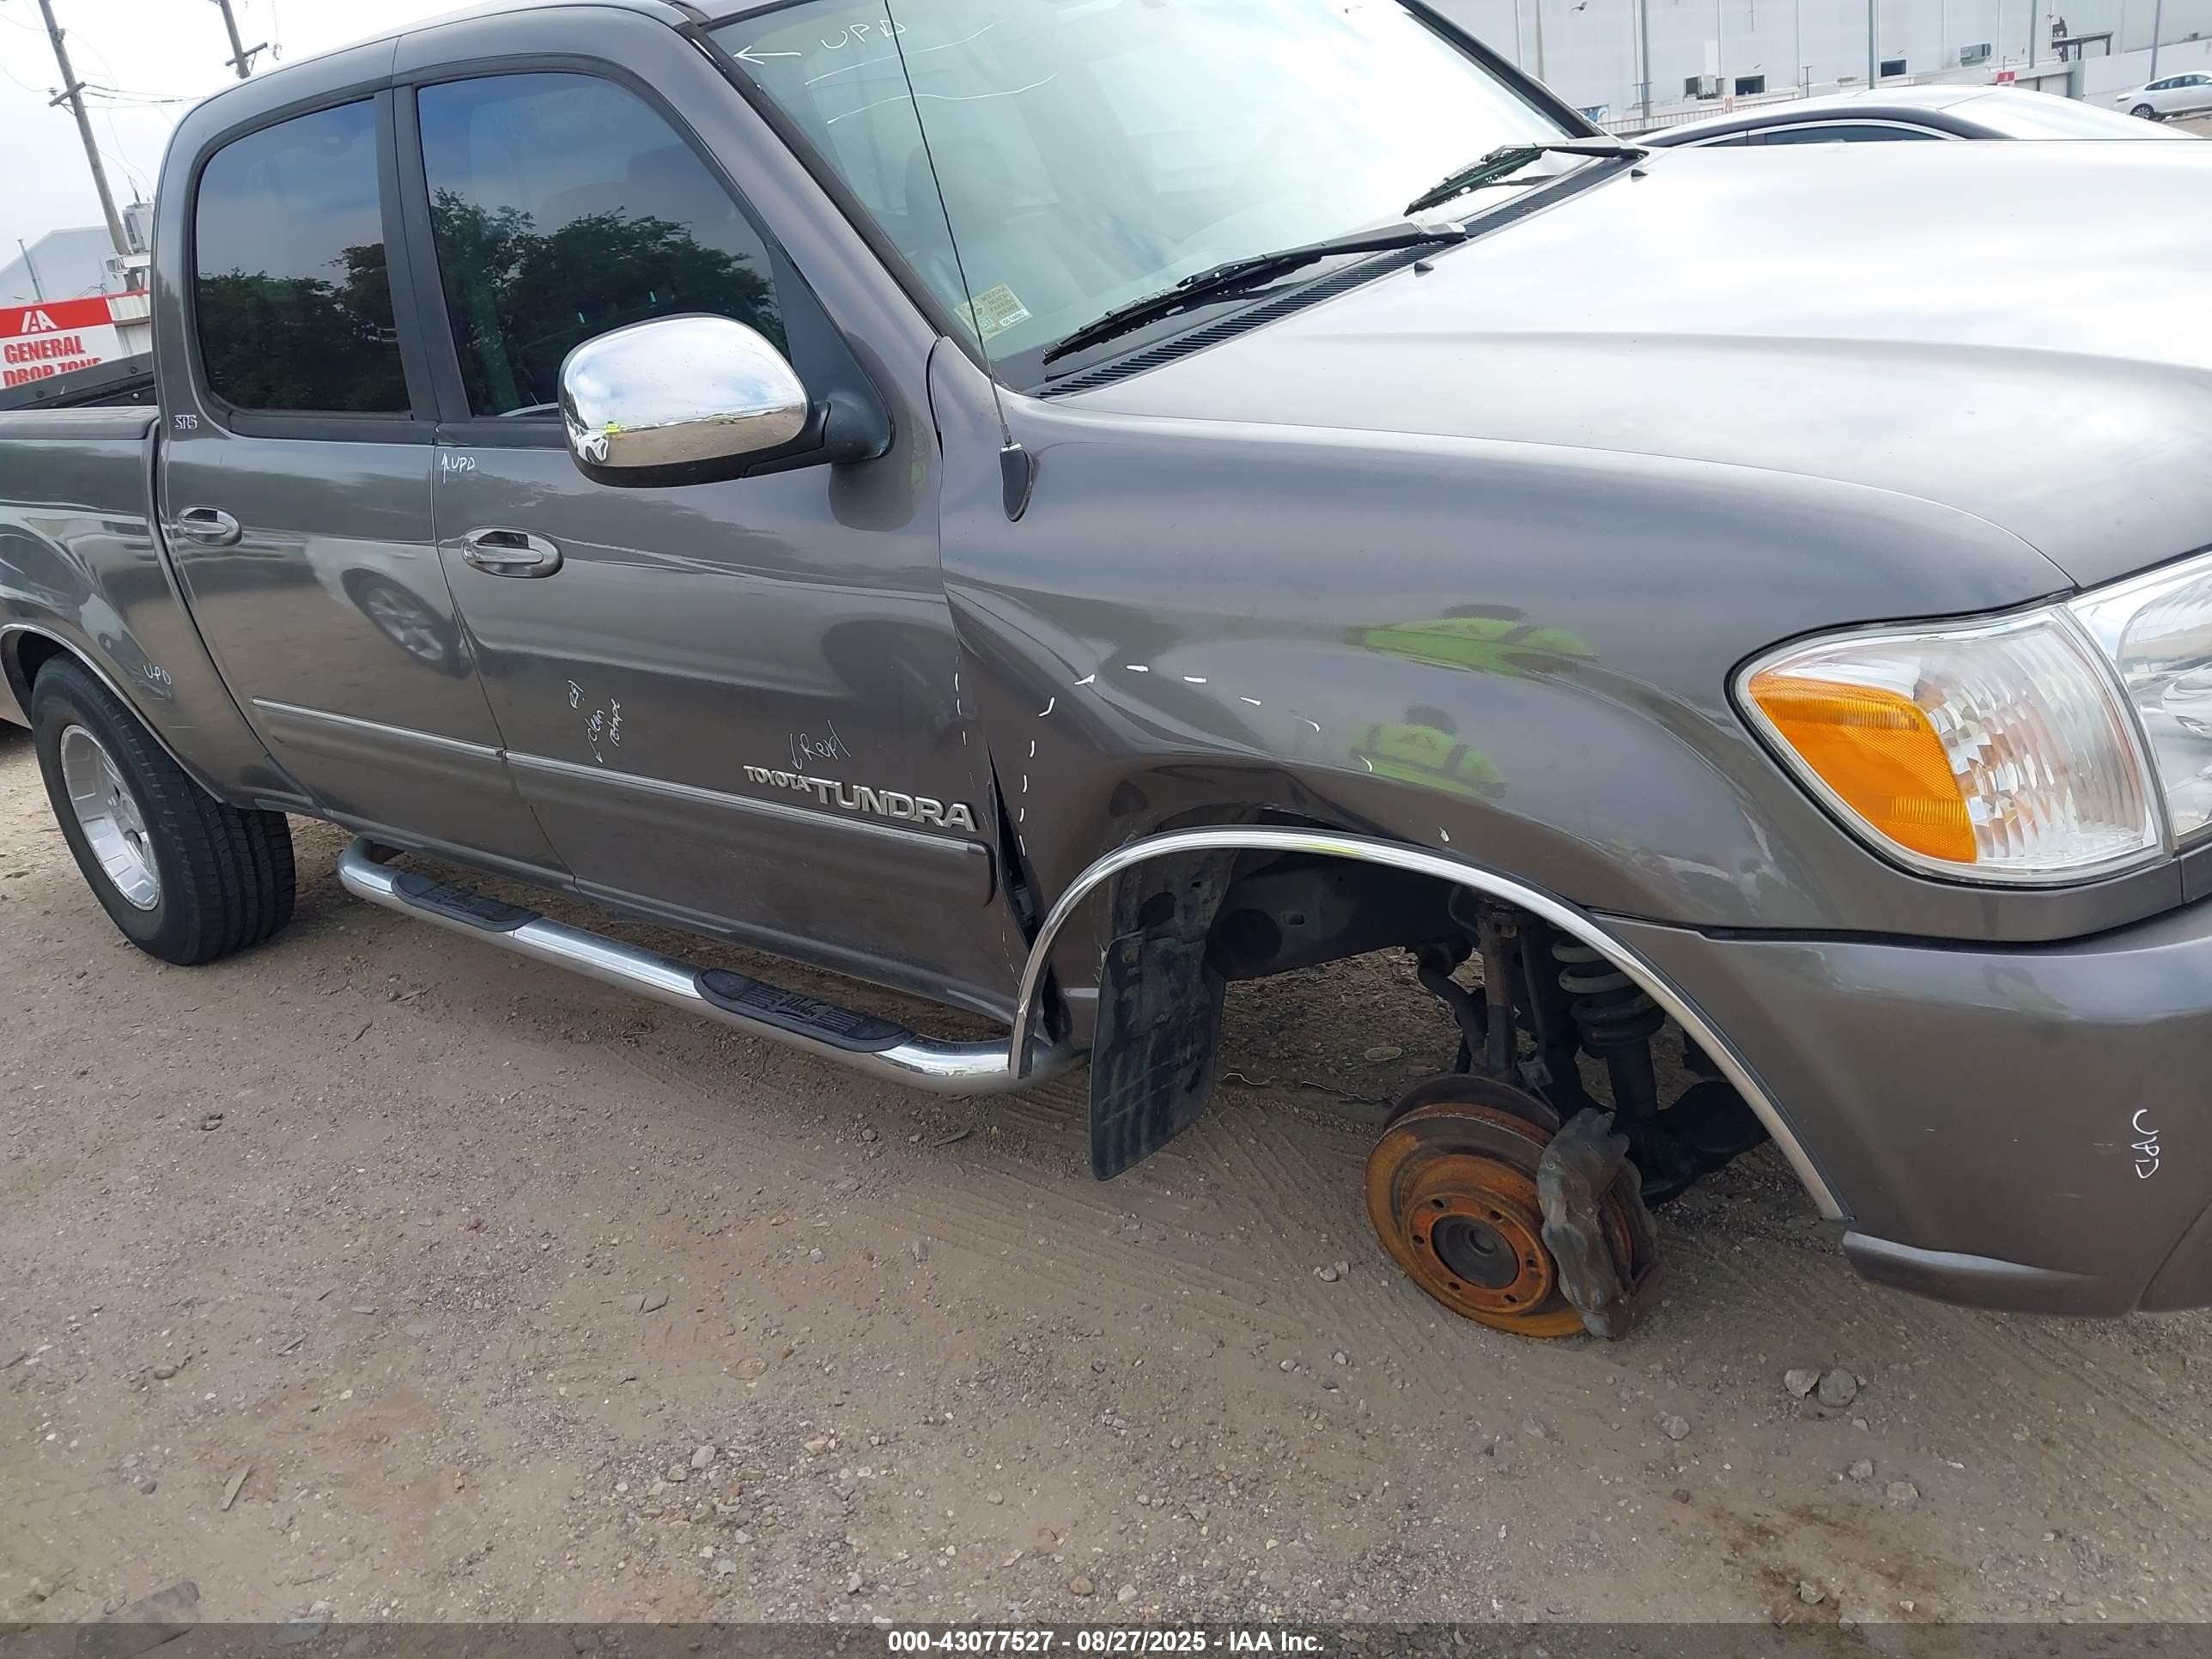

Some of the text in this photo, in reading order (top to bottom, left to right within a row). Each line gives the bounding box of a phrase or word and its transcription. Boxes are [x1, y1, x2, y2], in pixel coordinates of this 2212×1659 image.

[820, 19, 907, 49] UPD
[3, 335, 85, 364] GENERAL
[3, 364, 55, 386] DROP
[174, 415, 198, 429] SR5
[451, 454, 476, 474] UPD
[743, 765, 977, 832] TOYOTA TUNDRA
